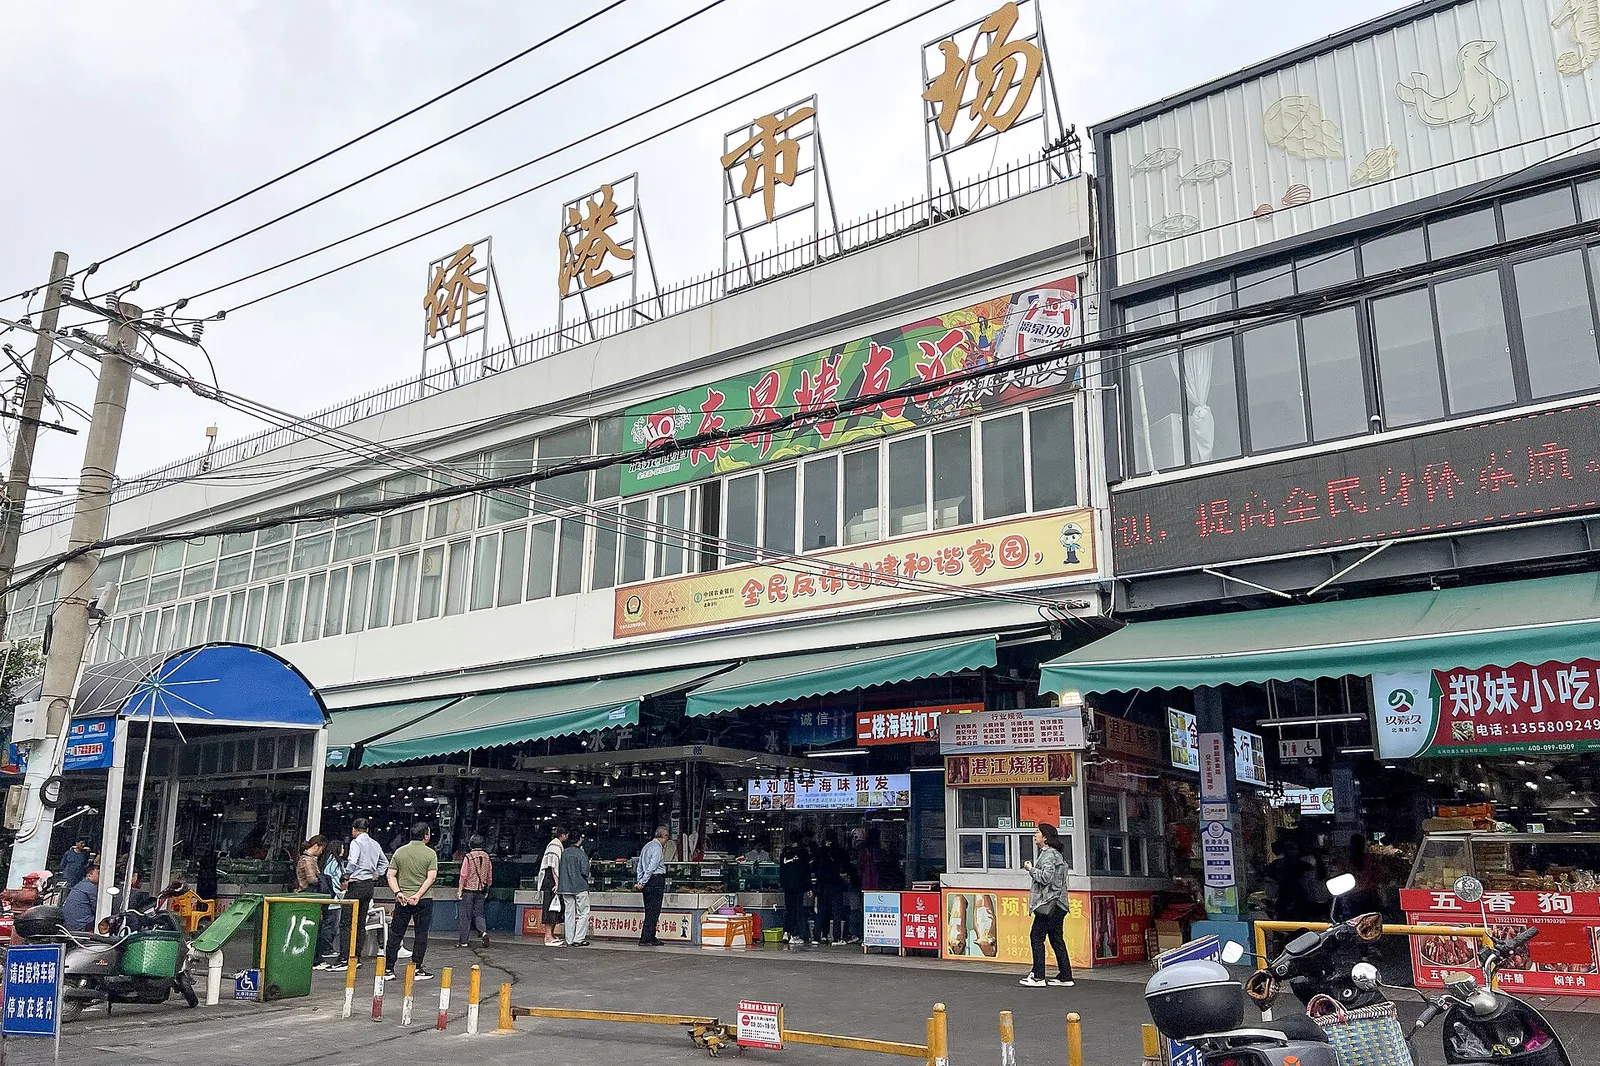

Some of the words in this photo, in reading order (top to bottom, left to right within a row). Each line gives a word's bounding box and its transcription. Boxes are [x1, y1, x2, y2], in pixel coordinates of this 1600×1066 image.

[424, 4, 1042, 337] 侨港市场
[1449, 666, 1600, 718] 郑妹小吃
[800, 711, 829, 727] 诚信
[991, 713, 1024, 721] 行业规范
[971, 756, 1047, 776] 湛江烧猪
[1429, 891, 1600, 914] 五香狗
[282, 915, 315, 954] 15
[905, 925, 937, 939] 监督岗
[10, 962, 56, 984] 请自觉将车辆
[8, 996, 53, 1020] 停放在线内
